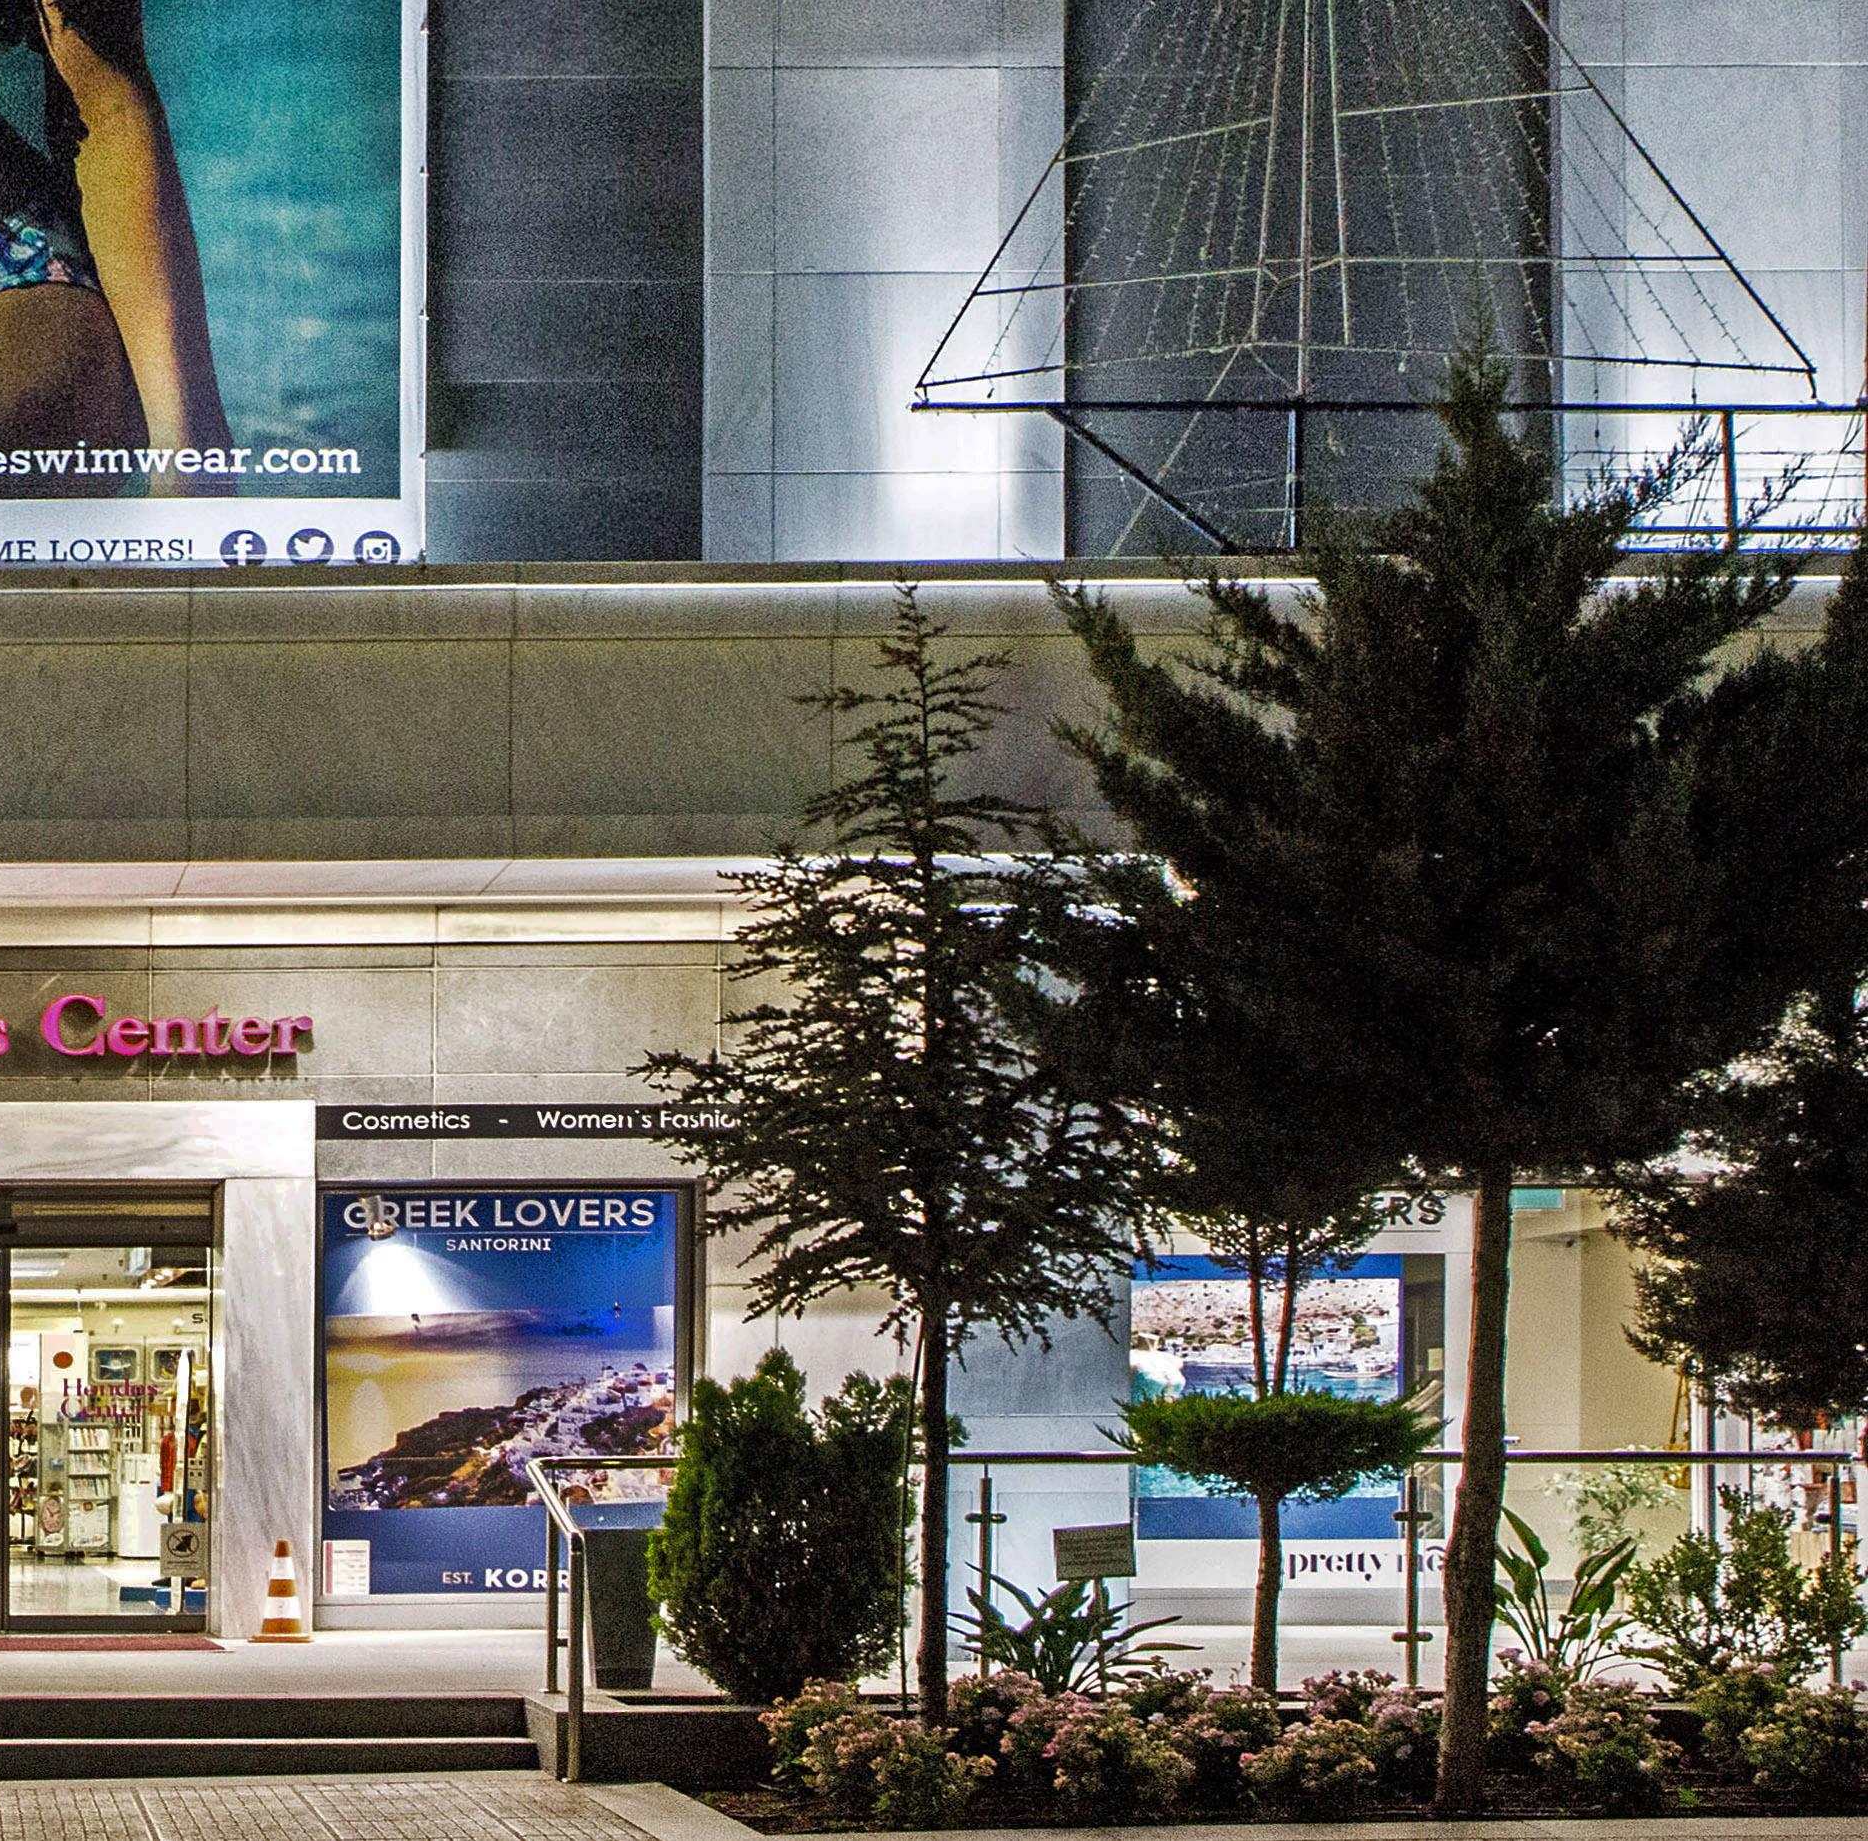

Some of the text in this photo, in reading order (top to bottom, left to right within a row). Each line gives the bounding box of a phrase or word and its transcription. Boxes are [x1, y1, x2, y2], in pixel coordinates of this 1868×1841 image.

[49, 538, 195, 563] LOVERS!
[40, 994, 314, 1057] Center
[342, 1109, 471, 1131] Cosmetics
[494, 1198, 656, 1227] LOVERS
[445, 1237, 552, 1253] SANTORINI
[62, 1377, 159, 1398] Hondos
[442, 1571, 474, 1585] EST.
[1288, 1552, 1388, 1582] pretty
